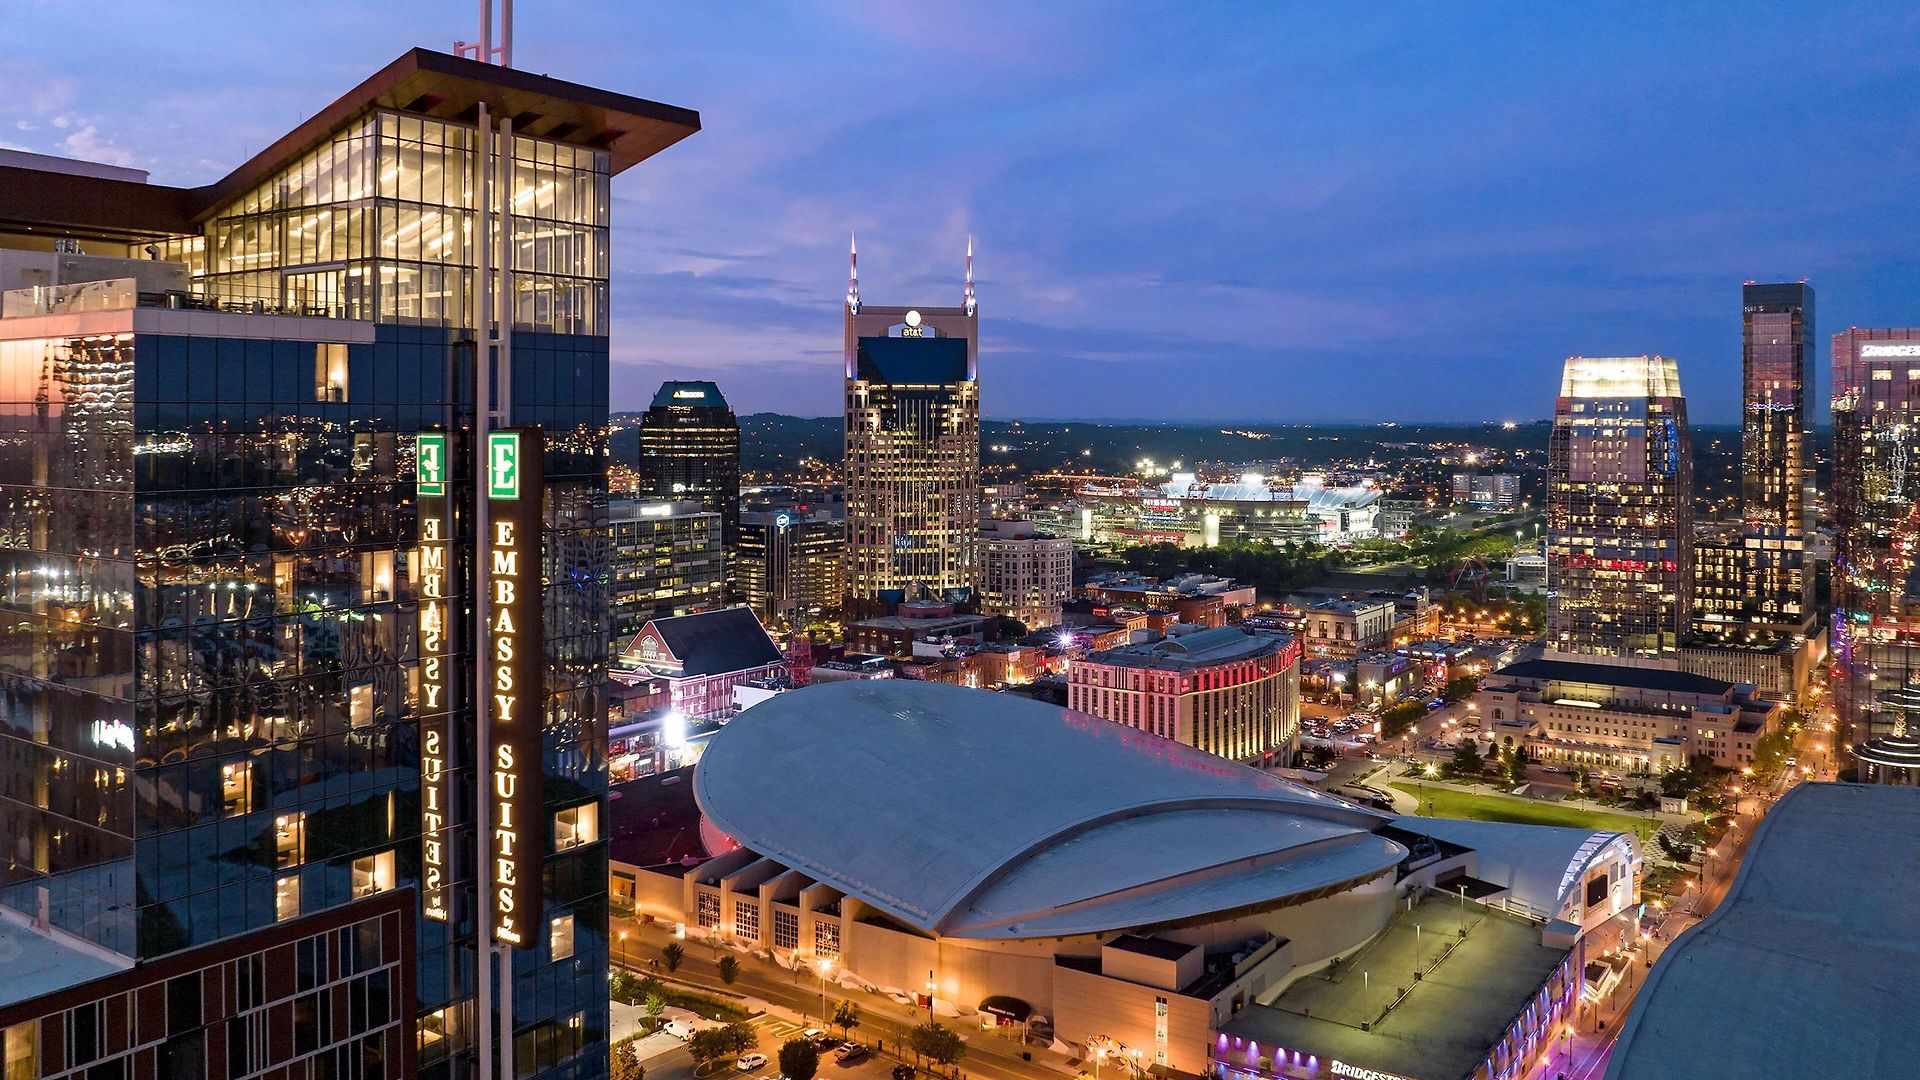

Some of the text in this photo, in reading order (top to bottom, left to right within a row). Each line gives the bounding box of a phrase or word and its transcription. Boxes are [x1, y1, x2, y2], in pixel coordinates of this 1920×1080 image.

[1143, 499, 1180, 507] NISSAN
[492, 521, 518, 913] EMBASSY SUITES
